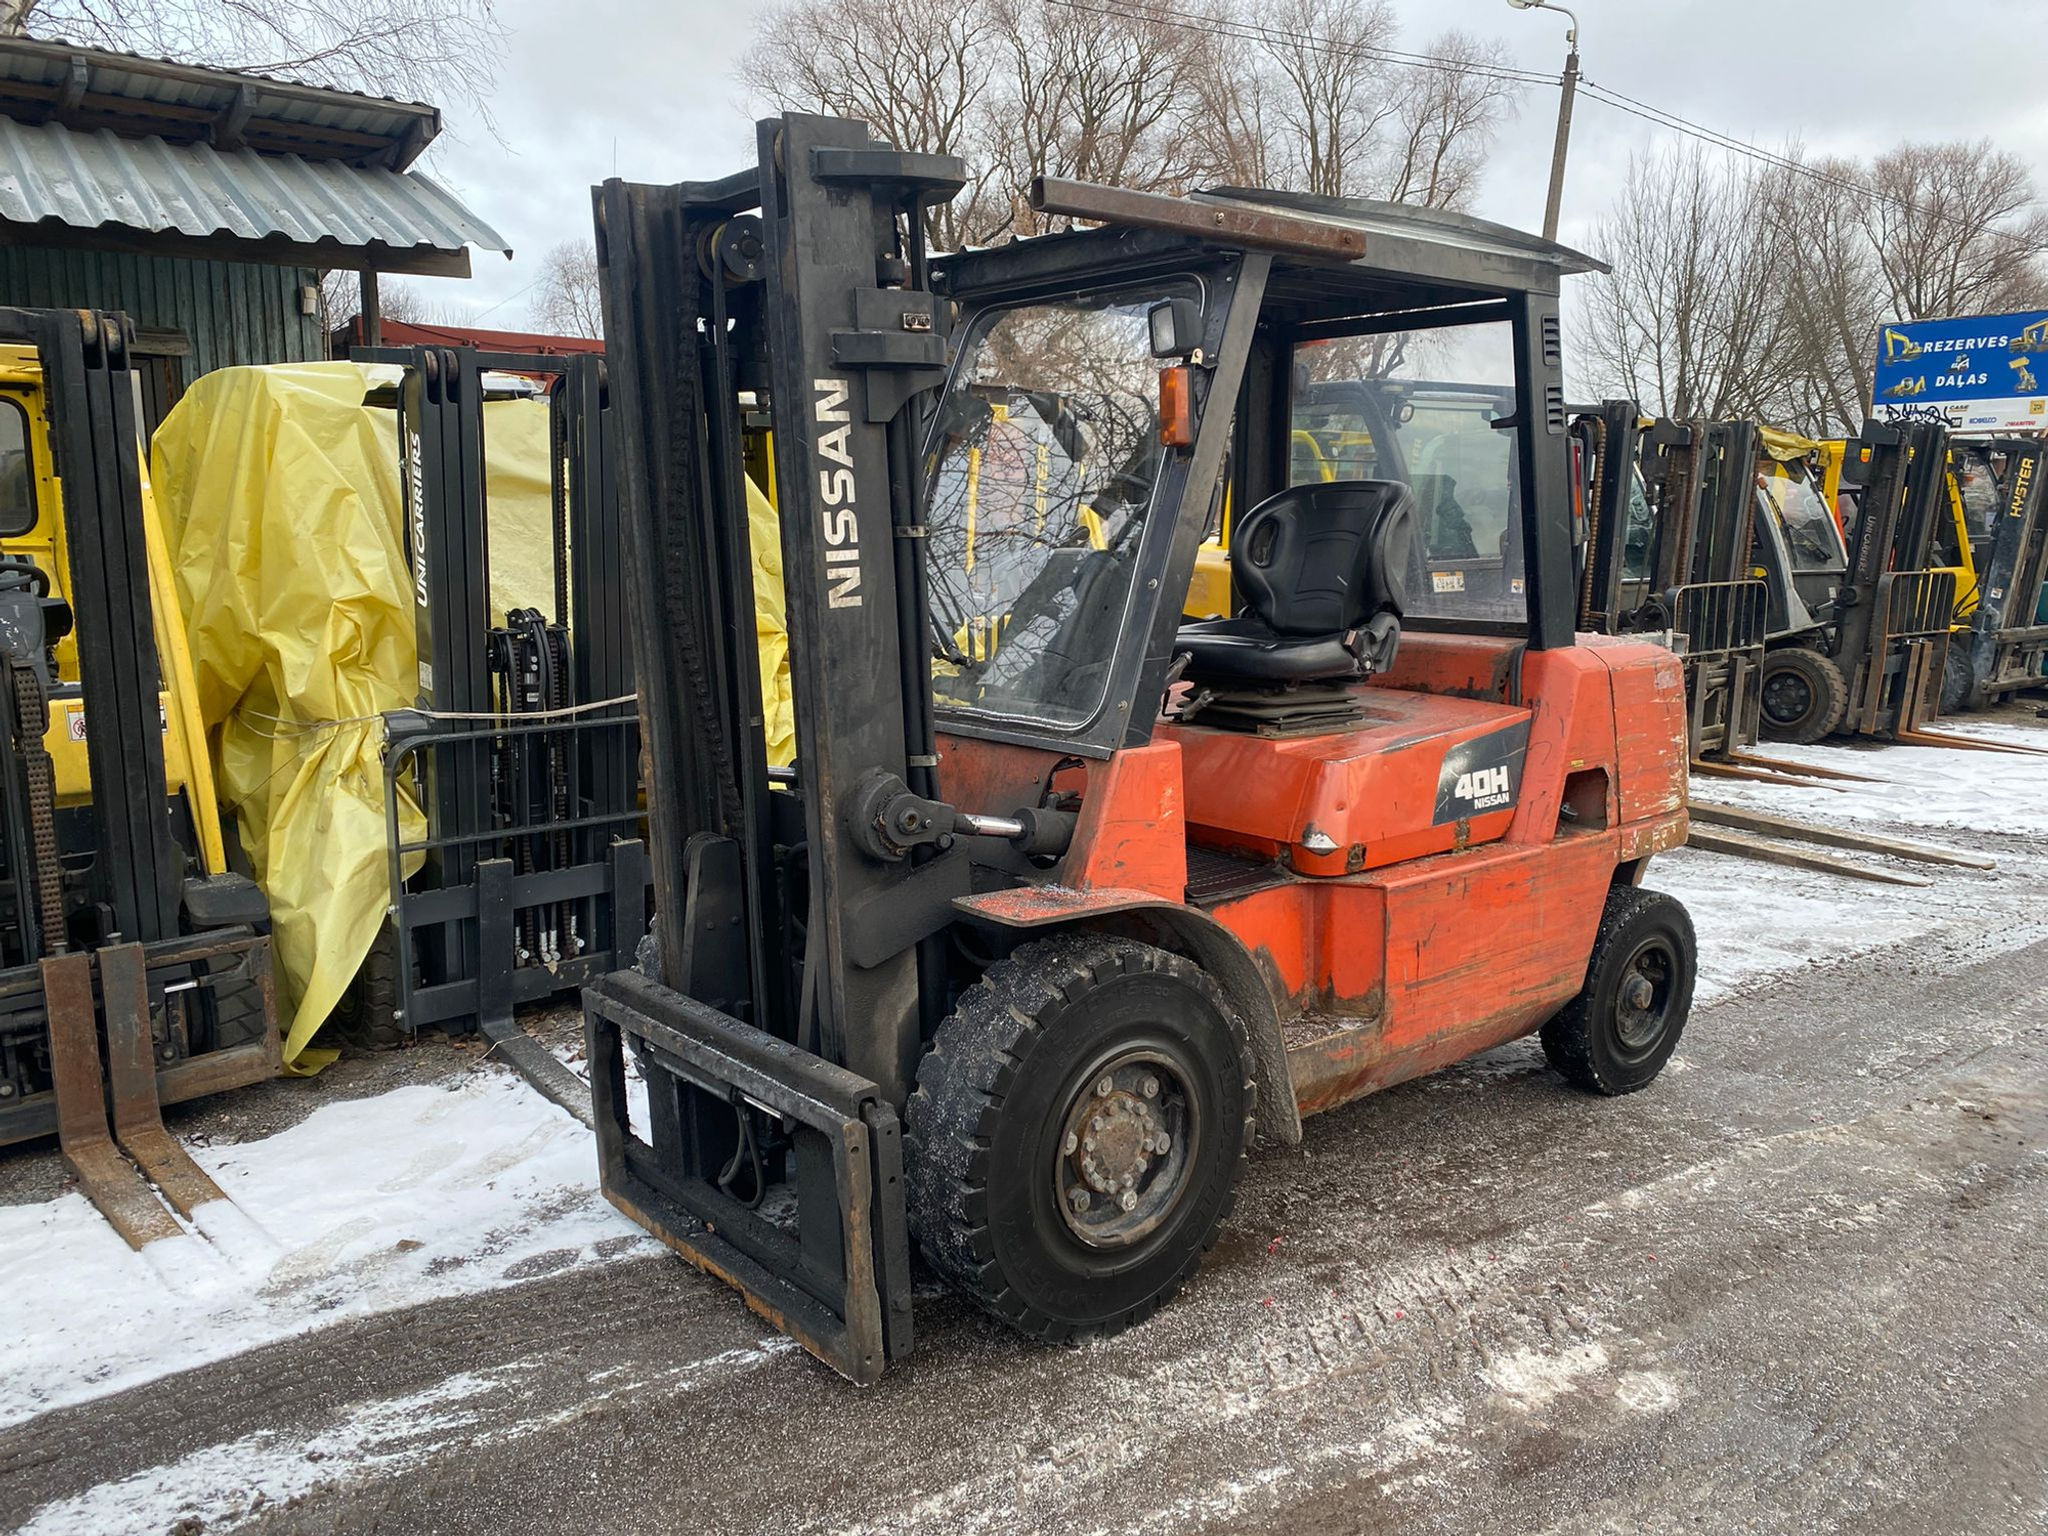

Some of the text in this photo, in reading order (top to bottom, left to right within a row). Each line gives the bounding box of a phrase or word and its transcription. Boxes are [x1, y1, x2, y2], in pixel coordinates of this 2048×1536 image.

[1923, 336, 2009, 353] REZERVES
[1935, 373, 1988, 388] DAĻAS
[814, 378, 863, 609] NISSAN
[2009, 457, 2035, 518] HYSTER
[1454, 765, 1509, 800] 40H
[1473, 792, 1510, 810] NISSAN
